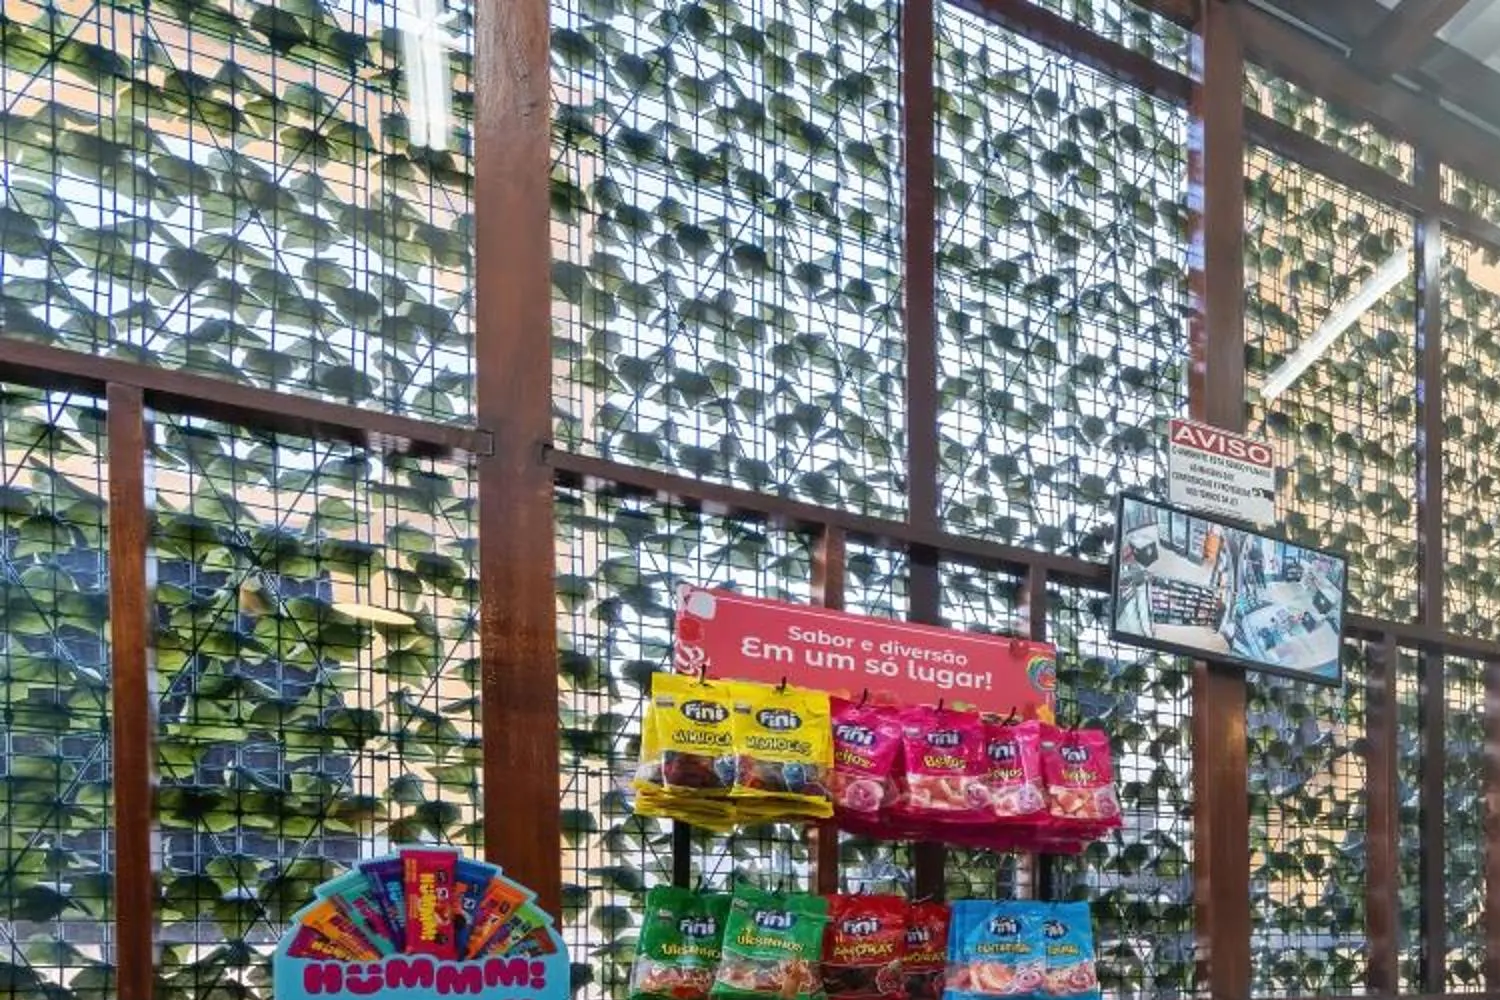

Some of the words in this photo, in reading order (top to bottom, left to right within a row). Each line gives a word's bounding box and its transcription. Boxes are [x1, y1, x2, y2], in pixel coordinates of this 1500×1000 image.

[1174, 425, 1270, 464] AVISO
[741, 636, 794, 663] Em
[805, 650, 856, 671] um
[865, 656, 900, 678] só
[907, 659, 993, 691] lugar!
[788, 625, 855, 650] Sabor
[861, 639, 873, 651] e
[879, 639, 968, 666] diversão
